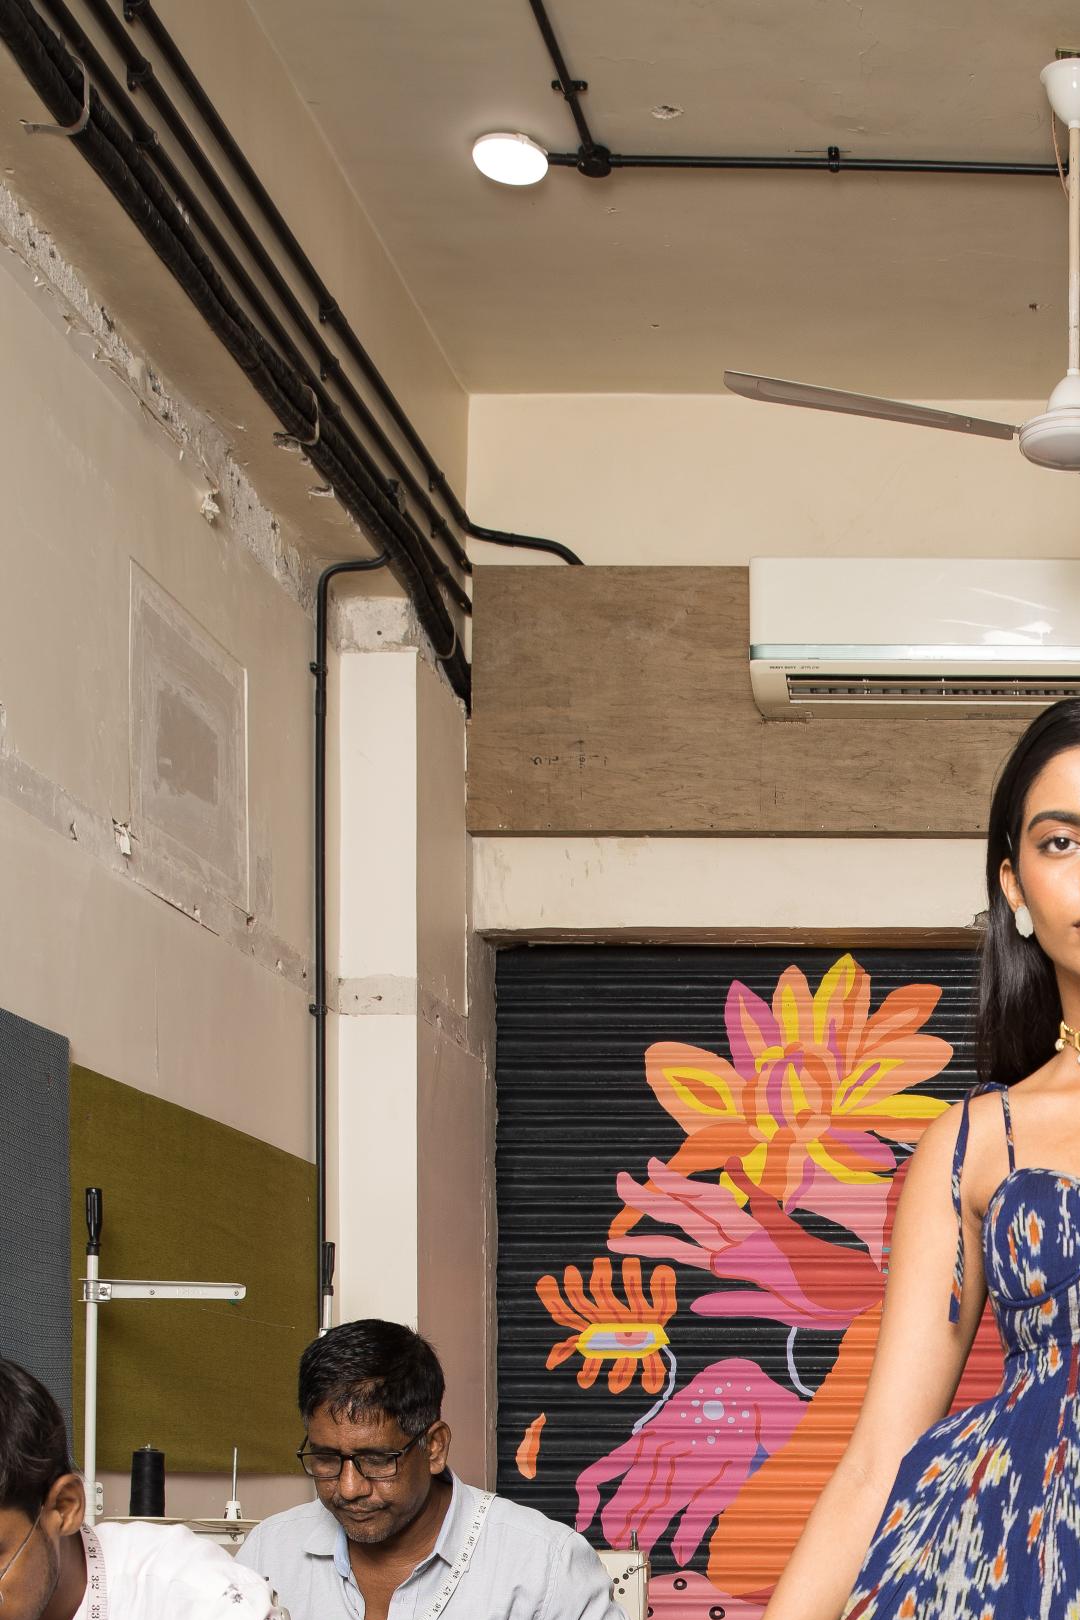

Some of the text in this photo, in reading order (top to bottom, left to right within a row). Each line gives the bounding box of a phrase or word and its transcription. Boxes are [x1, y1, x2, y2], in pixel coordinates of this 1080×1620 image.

[88, 1546, 97, 1558] 31
[432, 1603, 441, 1613] 46
[443, 1586, 451, 1596] 47
[453, 1570, 461, 1579] 48
[461, 1552, 469, 1563] 49
[467, 1536, 475, 1546] 50
[91, 1575, 99, 1590] 32
[91, 1604, 100, 1619] 33
